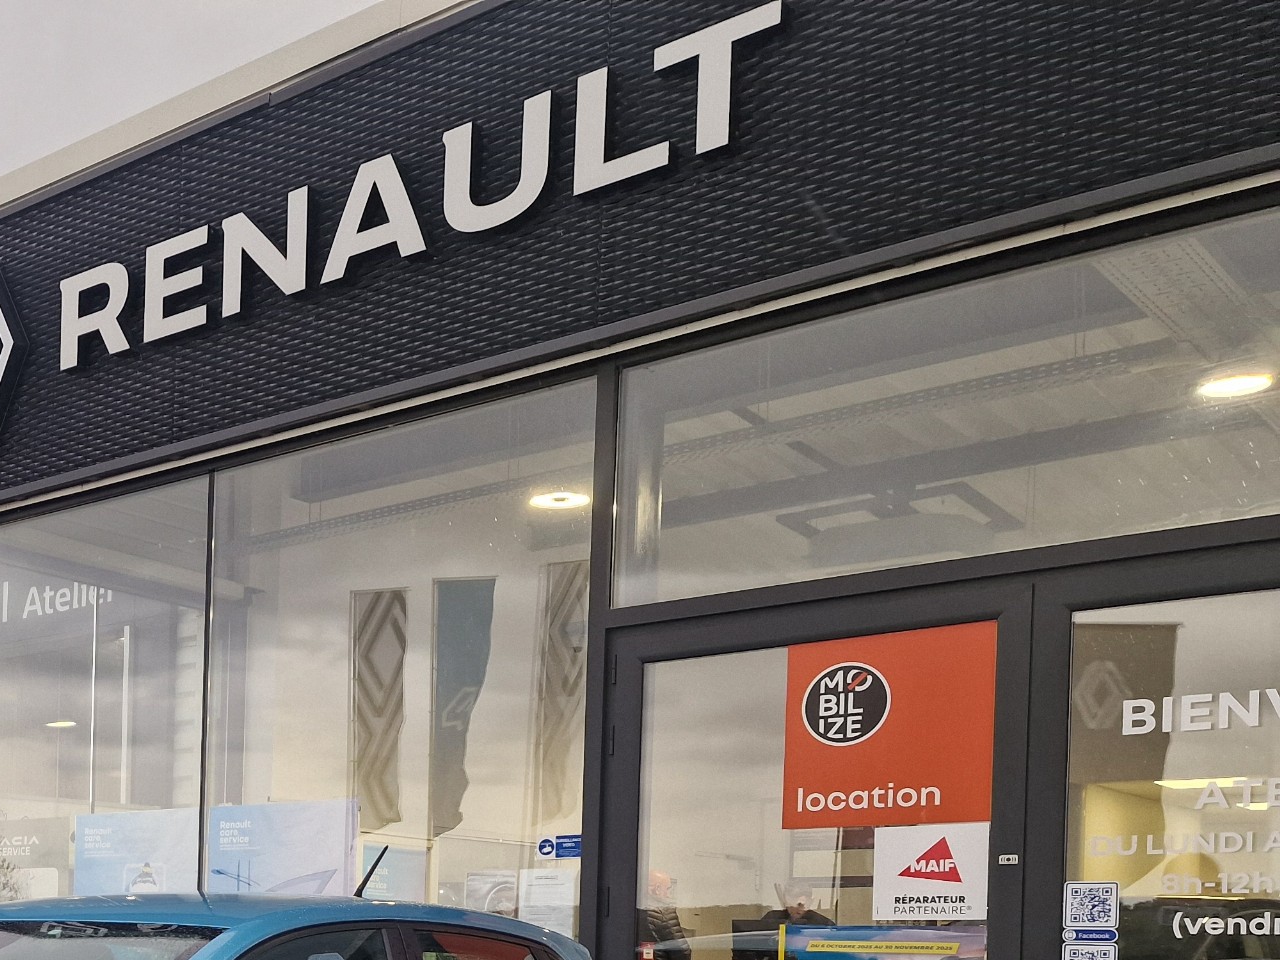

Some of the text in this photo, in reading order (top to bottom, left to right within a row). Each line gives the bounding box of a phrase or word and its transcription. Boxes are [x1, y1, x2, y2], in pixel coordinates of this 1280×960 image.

[59, 0, 783, 371] RENAULT
[819, 692, 864, 717] BIL
[819, 715, 863, 739] IZE
[796, 782, 941, 812] location
[1089, 834, 1138, 857] DU
[1146, 831, 1254, 855] LUNDI
[910, 859, 956, 873] MAIF
[894, 893, 966, 905] RÉPARATEUR
